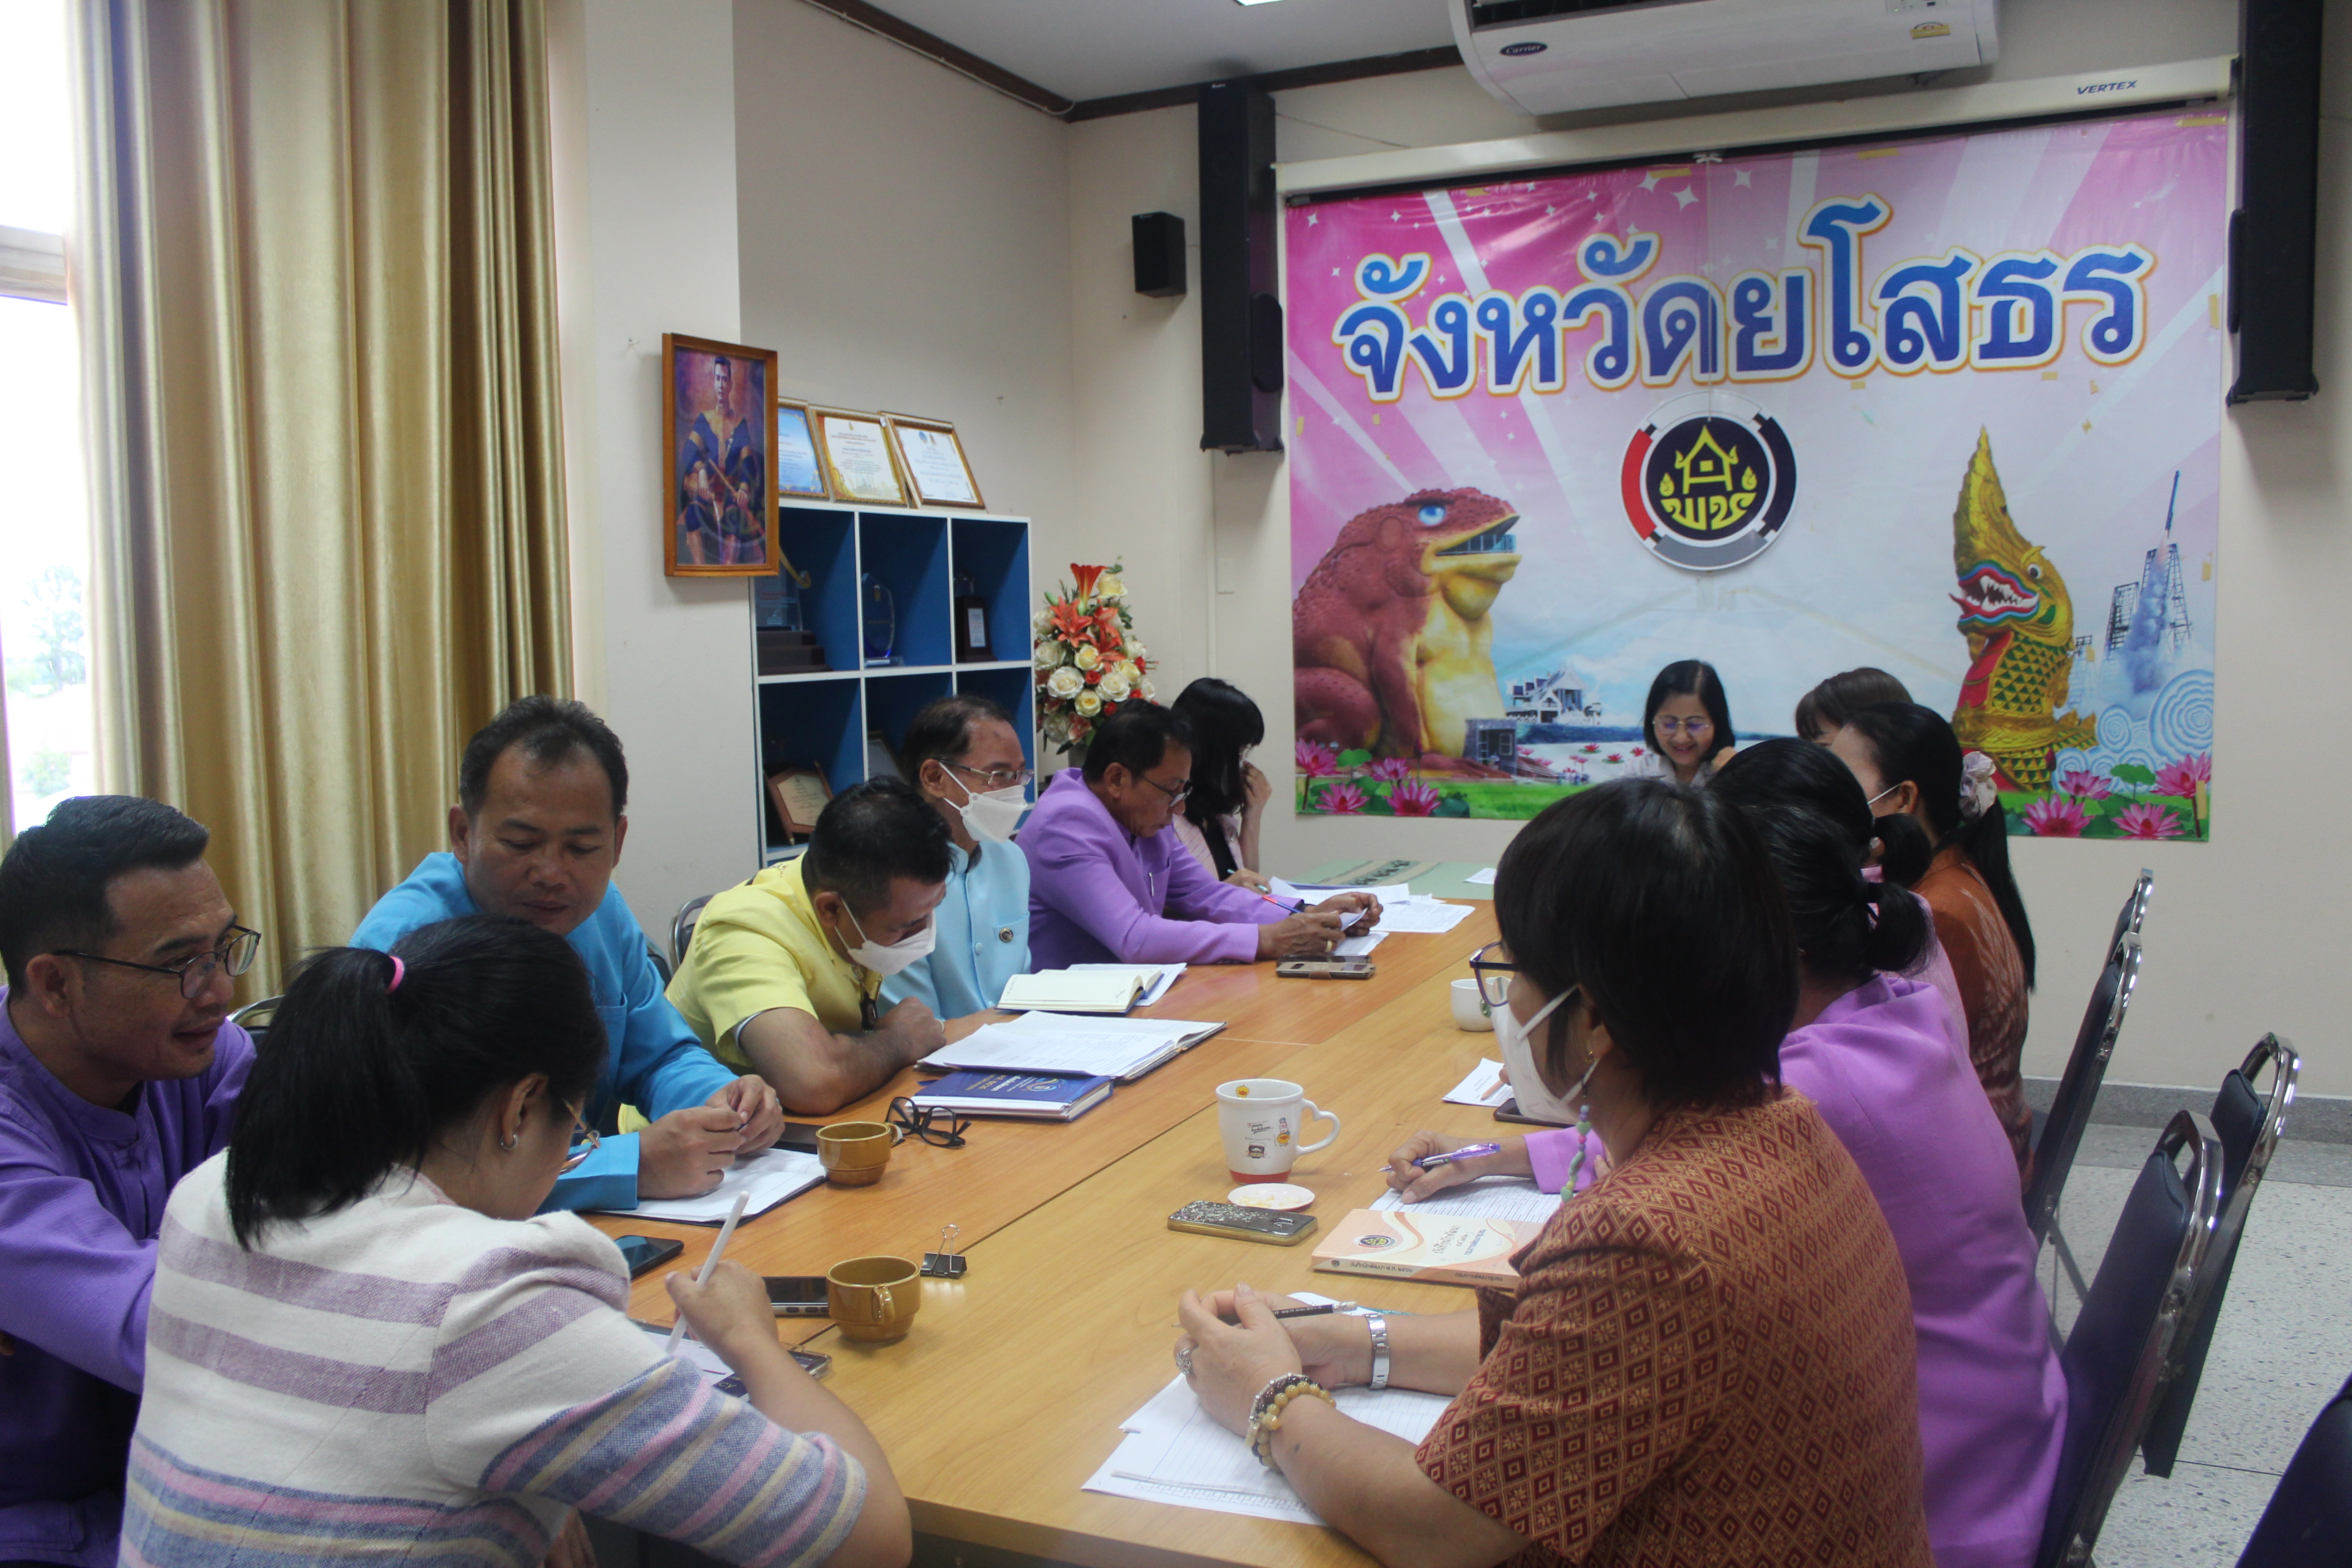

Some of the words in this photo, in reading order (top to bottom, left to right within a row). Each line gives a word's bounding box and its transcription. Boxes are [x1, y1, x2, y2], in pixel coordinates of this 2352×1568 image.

[1505, 45, 1542, 54] Carrier
[2077, 80, 2137, 94] VERTEX
[1335, 197, 2151, 398] จังหวัดยโสธร
[1349, 1261, 1385, 1270] บันทึกนักพัฒนา
